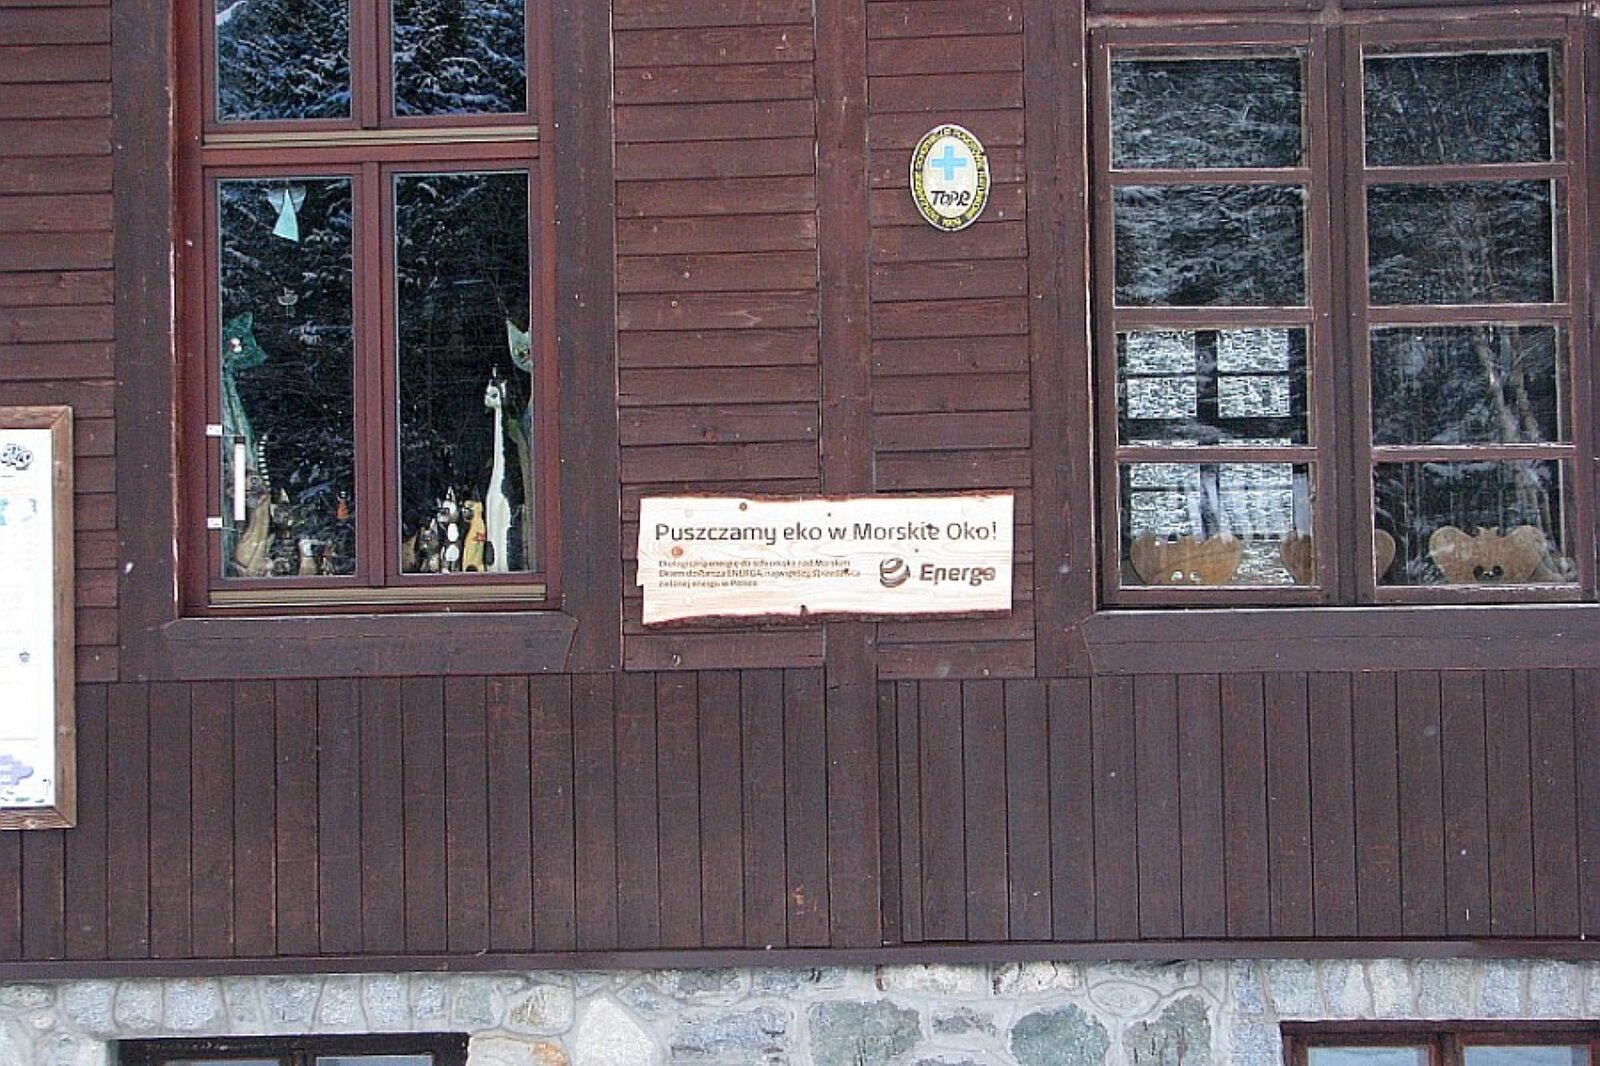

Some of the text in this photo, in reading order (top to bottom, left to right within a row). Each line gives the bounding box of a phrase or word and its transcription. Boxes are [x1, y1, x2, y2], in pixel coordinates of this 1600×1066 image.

[655, 521, 996, 545] Puszczamy eko w Morskie Oko!
